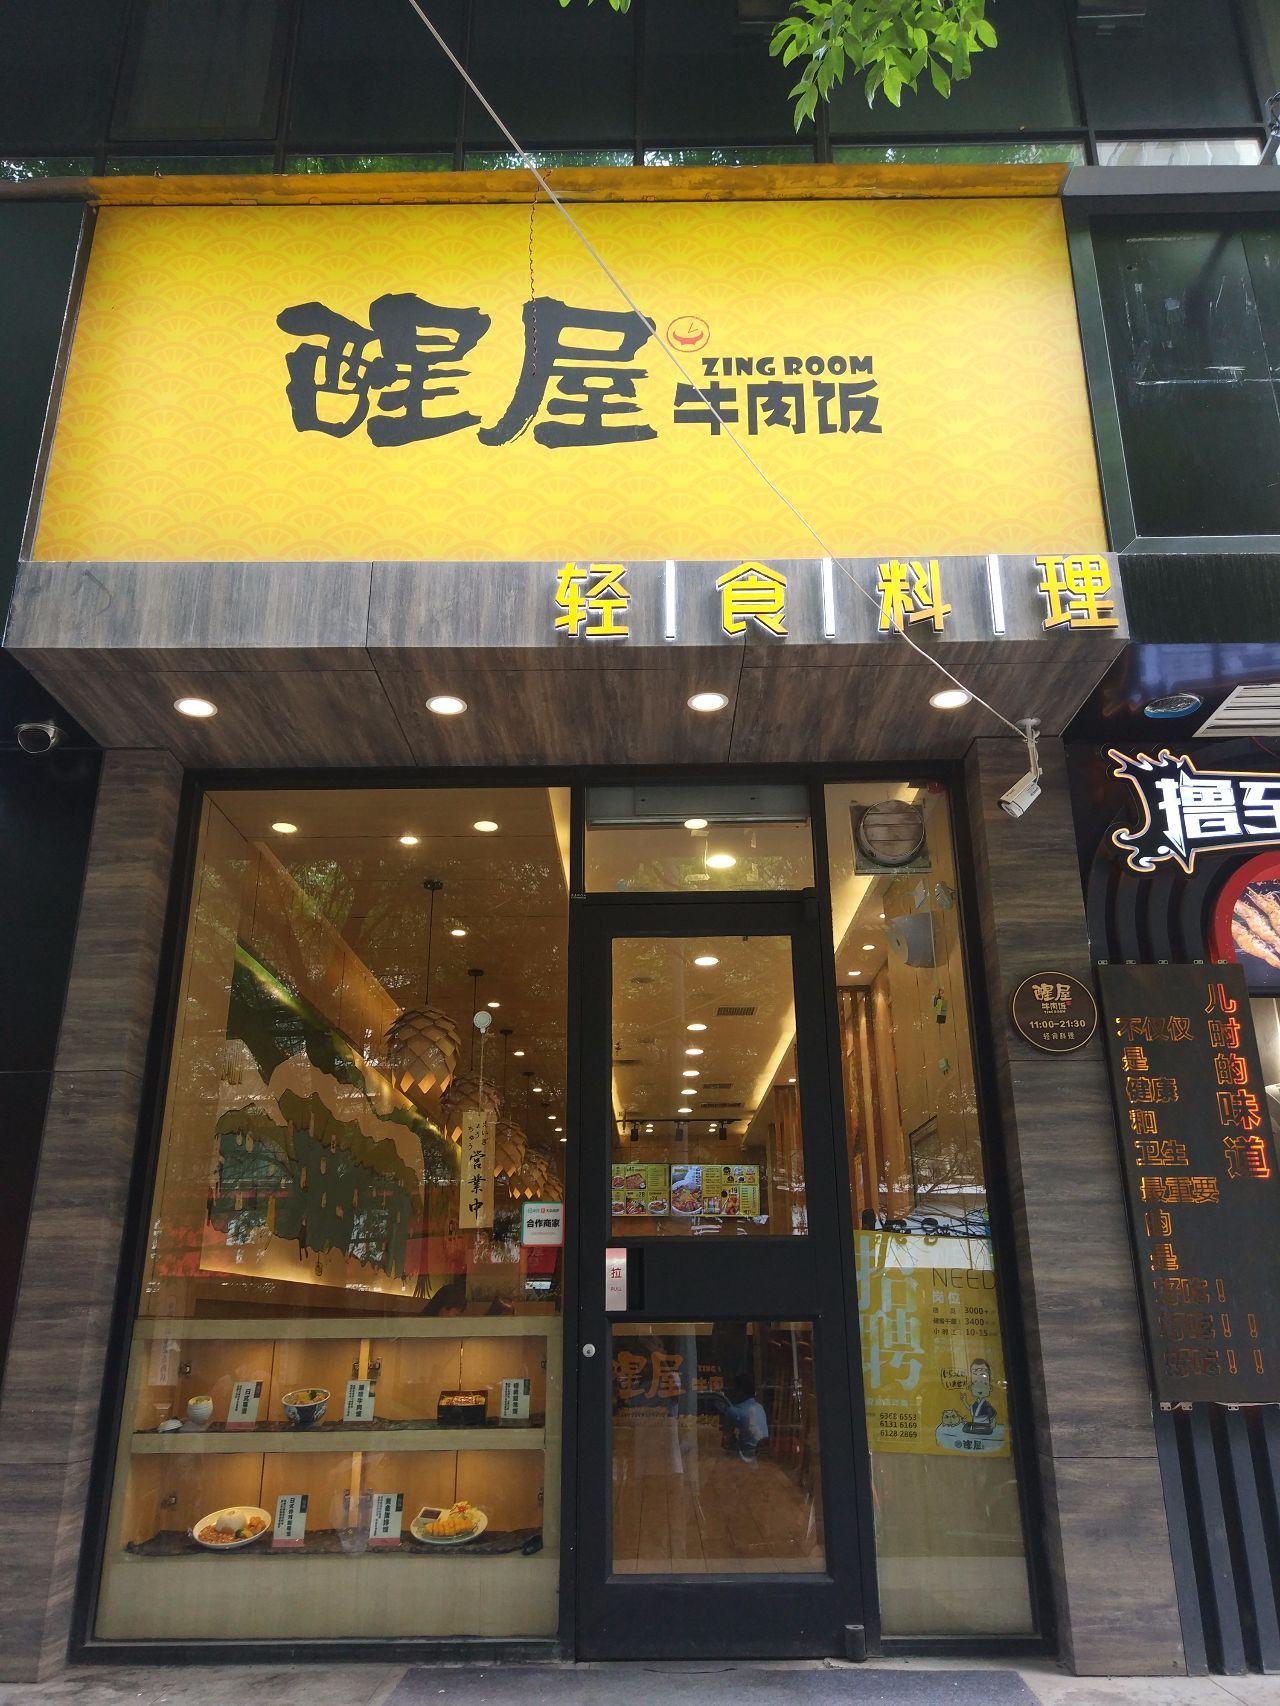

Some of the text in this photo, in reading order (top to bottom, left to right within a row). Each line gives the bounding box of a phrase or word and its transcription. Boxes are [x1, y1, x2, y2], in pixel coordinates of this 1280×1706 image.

[276, 292, 659, 449] 醒屋
[702, 356, 873, 376] ZING ROOM
[673, 379, 882, 435] 牛肉饭
[1031, 982, 1073, 1002] 醒屋
[1029, 1019, 1086, 1029] 11:00-21:30
[1115, 1016, 1194, 1042] 不仅仅
[1122, 1046, 1149, 1072] 是
[1126, 1076, 1180, 1104] 健康
[1204, 983, 1271, 1179] 儿时的味道
[1129, 1109, 1158, 1134] 和
[1134, 1140, 1190, 1166] 卫生
[526, 1218, 560, 1228] 合作商家
[611, 1267, 622, 1278] 拉
[932, 1267, 997, 1290] NEED
